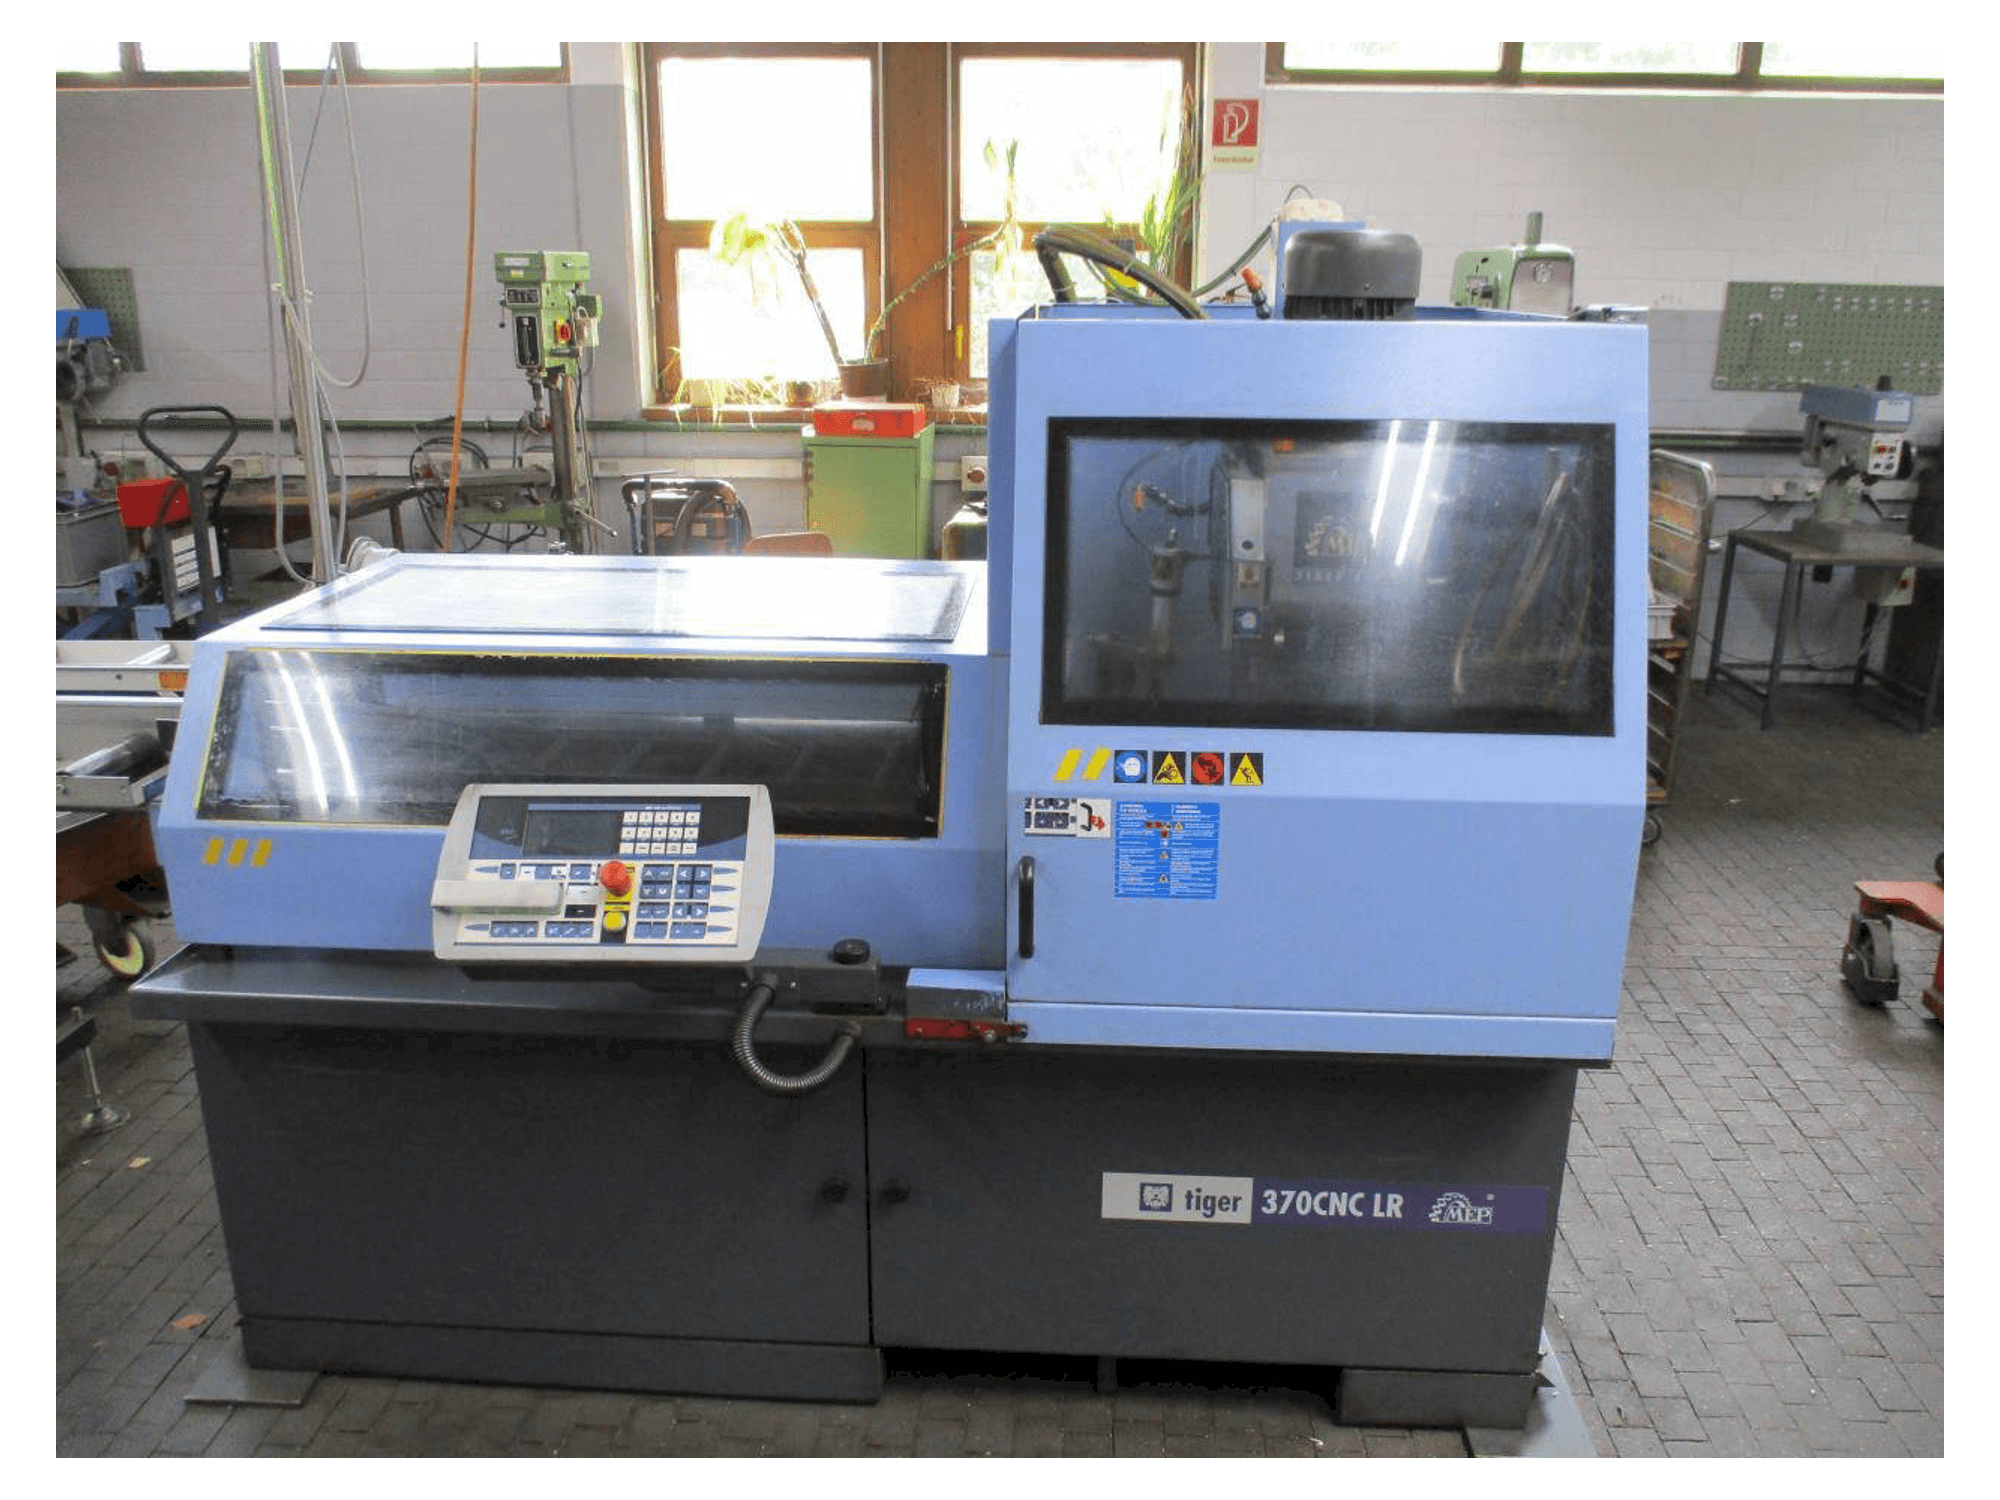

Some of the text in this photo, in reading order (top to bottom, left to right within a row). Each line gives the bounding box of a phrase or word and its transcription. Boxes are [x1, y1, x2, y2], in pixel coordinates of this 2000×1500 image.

[1185, 1187, 1242, 1218] tiger
[1261, 1189, 1404, 1218] 370CNC LR
